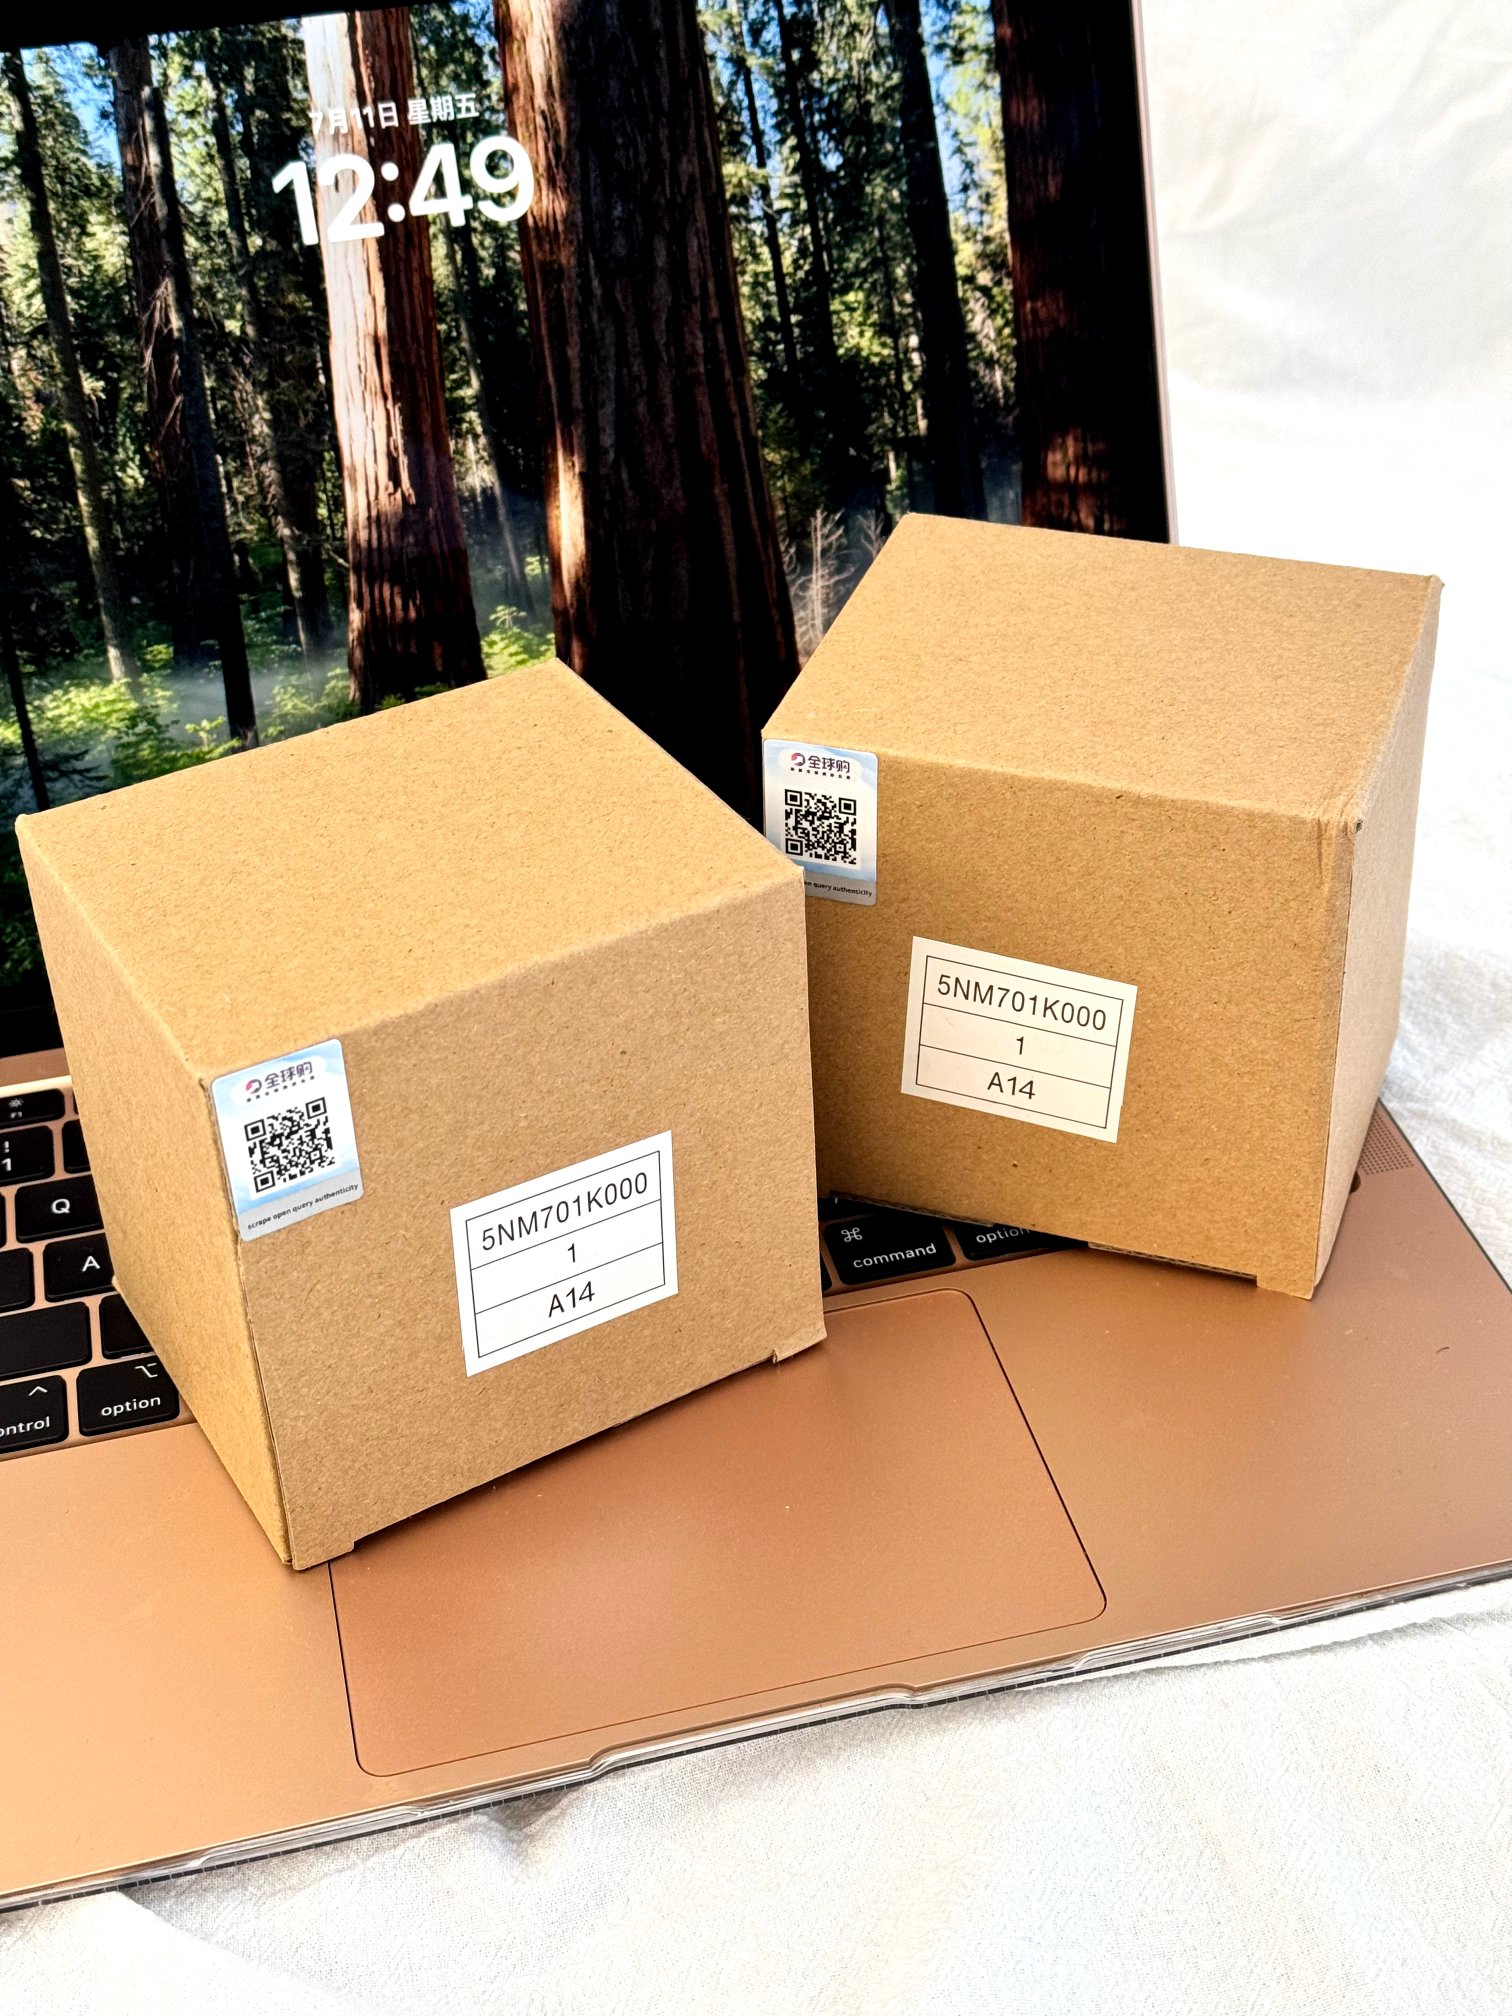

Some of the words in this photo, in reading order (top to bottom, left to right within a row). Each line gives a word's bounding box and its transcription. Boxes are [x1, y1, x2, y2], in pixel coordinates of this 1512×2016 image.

[308, 102, 399, 135] 7月11日
[407, 93, 480, 126] 星期五
[271, 135, 535, 246] 12:49
[808, 755, 851, 774] 全球购
[813, 882, 832, 891] query
[832, 885, 873, 897] authenticity
[937, 974, 1107, 1031] 5NM701K000
[1016, 1036, 1025, 1056] 1
[264, 1061, 313, 1089] 全球购
[987, 1071, 1037, 1100] A14
[2, 1158, 12, 1172] 1
[51, 1198, 71, 1214] Q
[247, 1216, 272, 1230] scrape
[273, 1208, 291, 1221] open
[292, 1199, 314, 1213] query
[314, 1183, 359, 1204] authenticity
[482, 1171, 648, 1251] 5NM701K000
[82, 1255, 100, 1273] A
[567, 1243, 576, 1263] 1
[853, 1243, 937, 1269] command
[548, 1281, 596, 1318] A14
[101, 1396, 161, 1417] option
